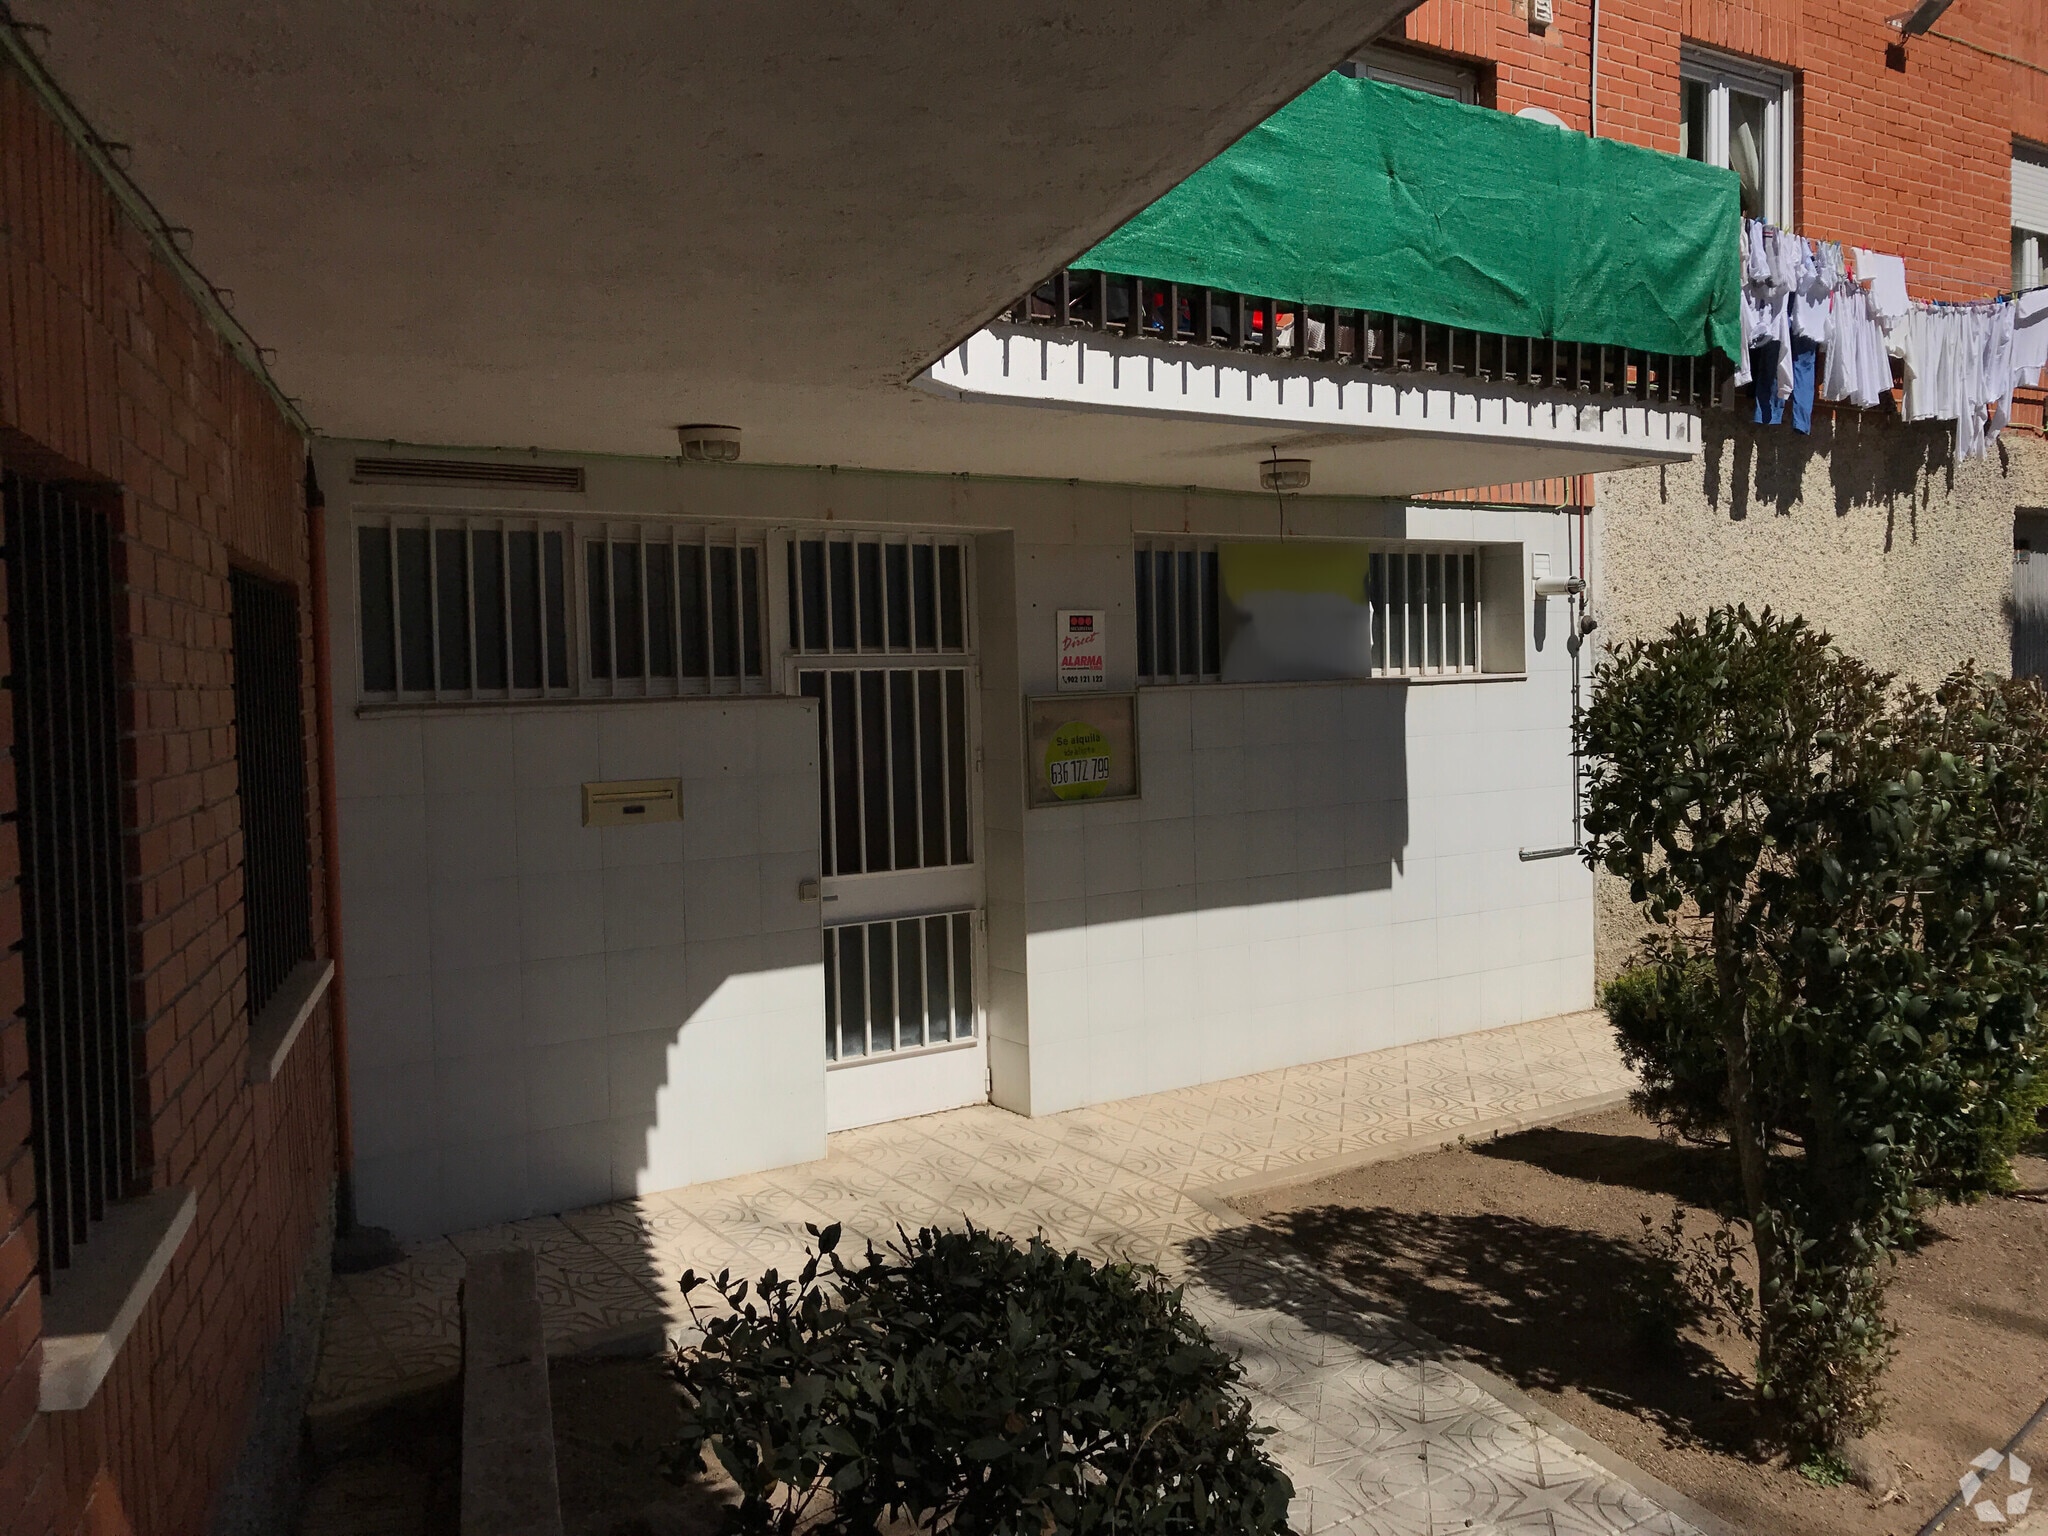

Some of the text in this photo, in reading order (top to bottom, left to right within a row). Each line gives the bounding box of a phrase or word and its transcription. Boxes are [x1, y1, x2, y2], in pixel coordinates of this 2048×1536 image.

[1062, 632, 1100, 651] Direct
[1061, 655, 1103, 666] ALARMA
[1067, 675, 1103, 683] 902 121 122
[1056, 733, 1101, 746] Se alquila
[1051, 762, 1069, 785] 636
[1092, 757, 1109, 780] 799
